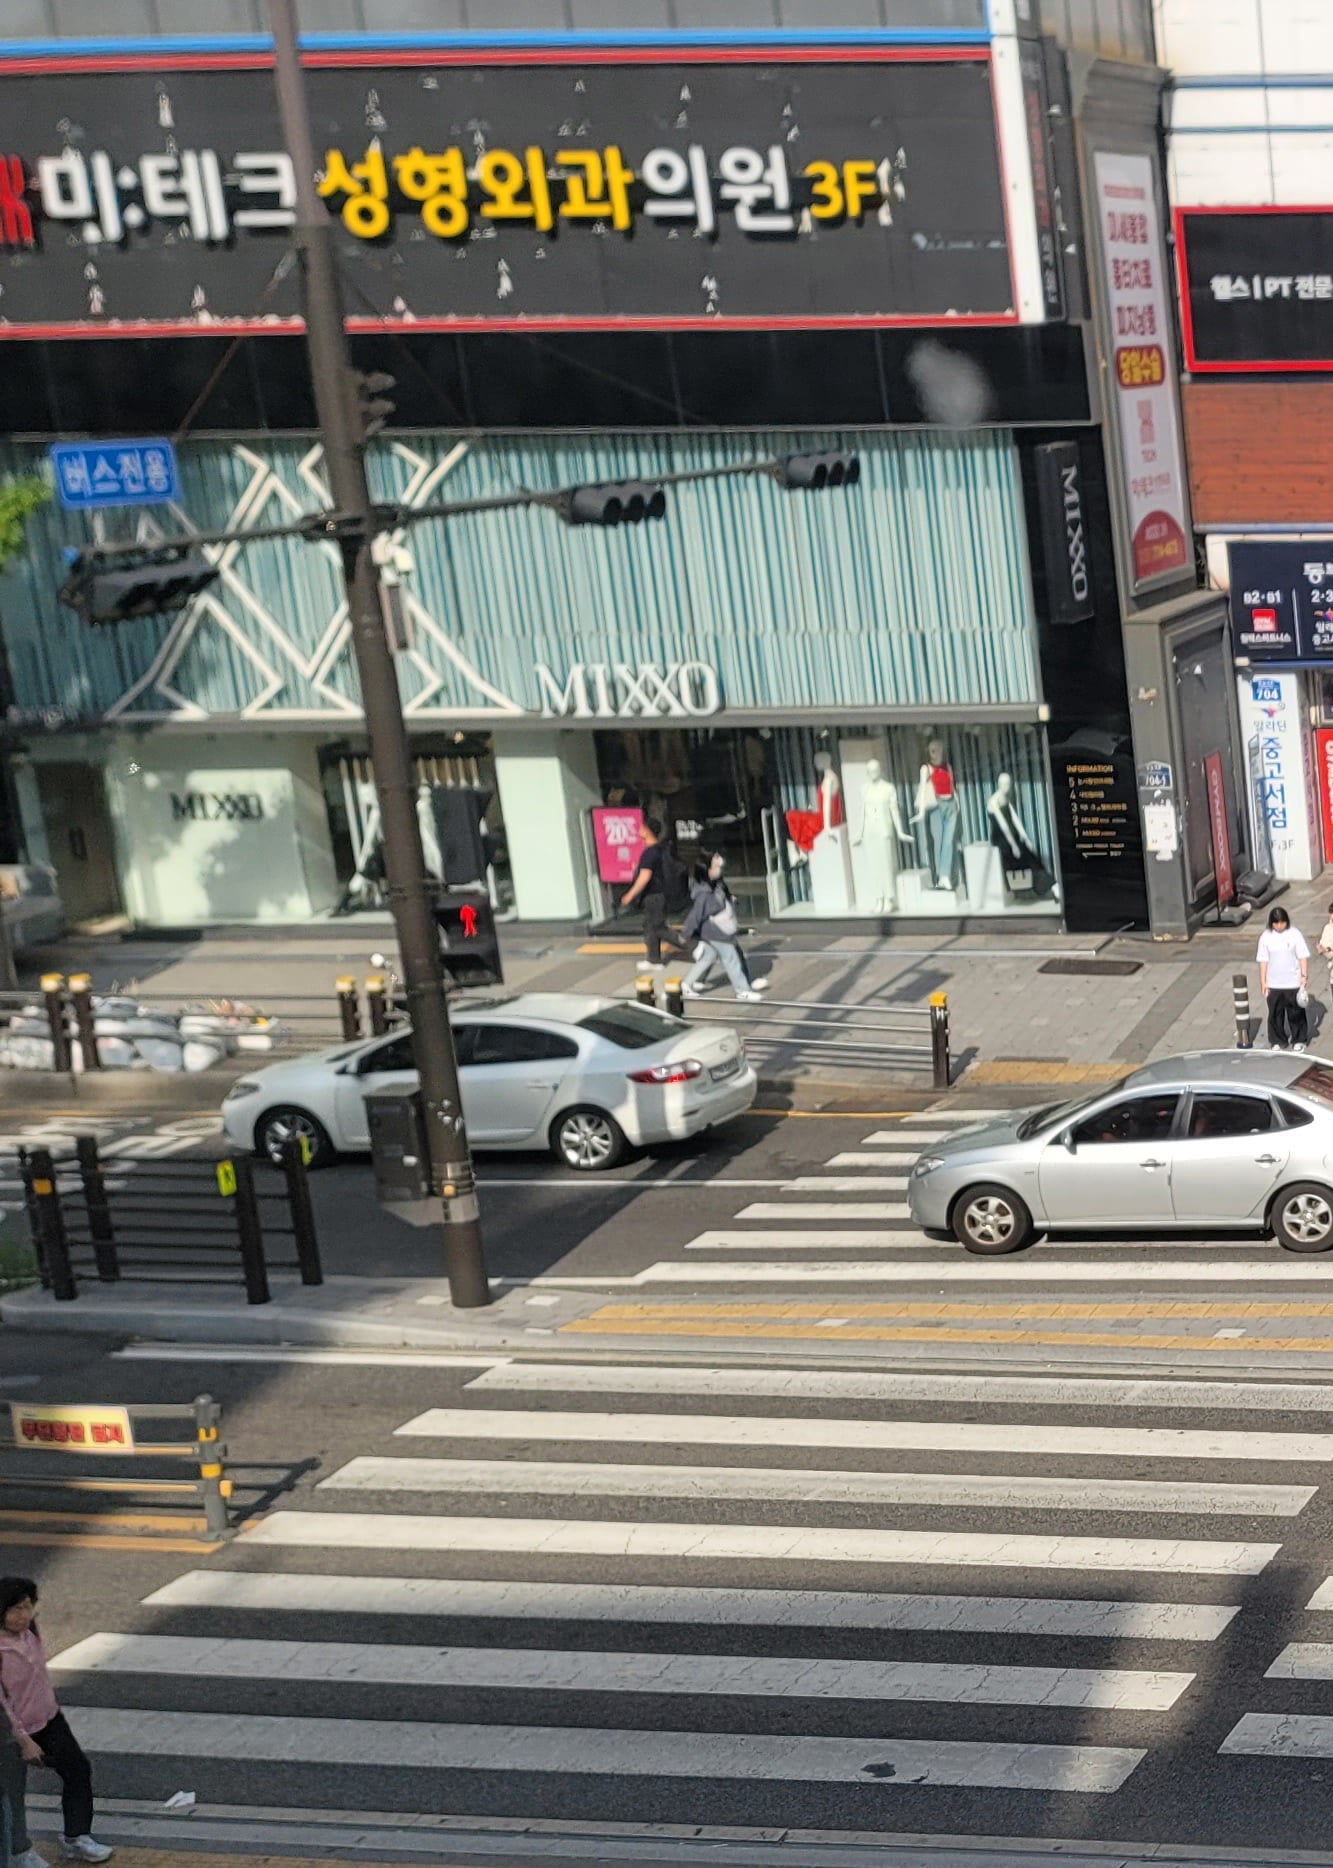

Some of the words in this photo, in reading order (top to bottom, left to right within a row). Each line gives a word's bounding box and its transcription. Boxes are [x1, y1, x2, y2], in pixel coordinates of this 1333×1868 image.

[805, 160, 878, 219] 3F
[1210, 276, 1250, 300] 헬스
[1265, 280, 1291, 297] PT
[1296, 276, 1333, 299] 전문
[62, 448, 169, 498] 버스전용
[1061, 464, 1088, 601] MIXXO
[535, 662, 723, 718] MIXXO
[1256, 689, 1279, 699] 704
[171, 792, 264, 821] MIXXO
[1261, 737, 1289, 829] 중고서점
